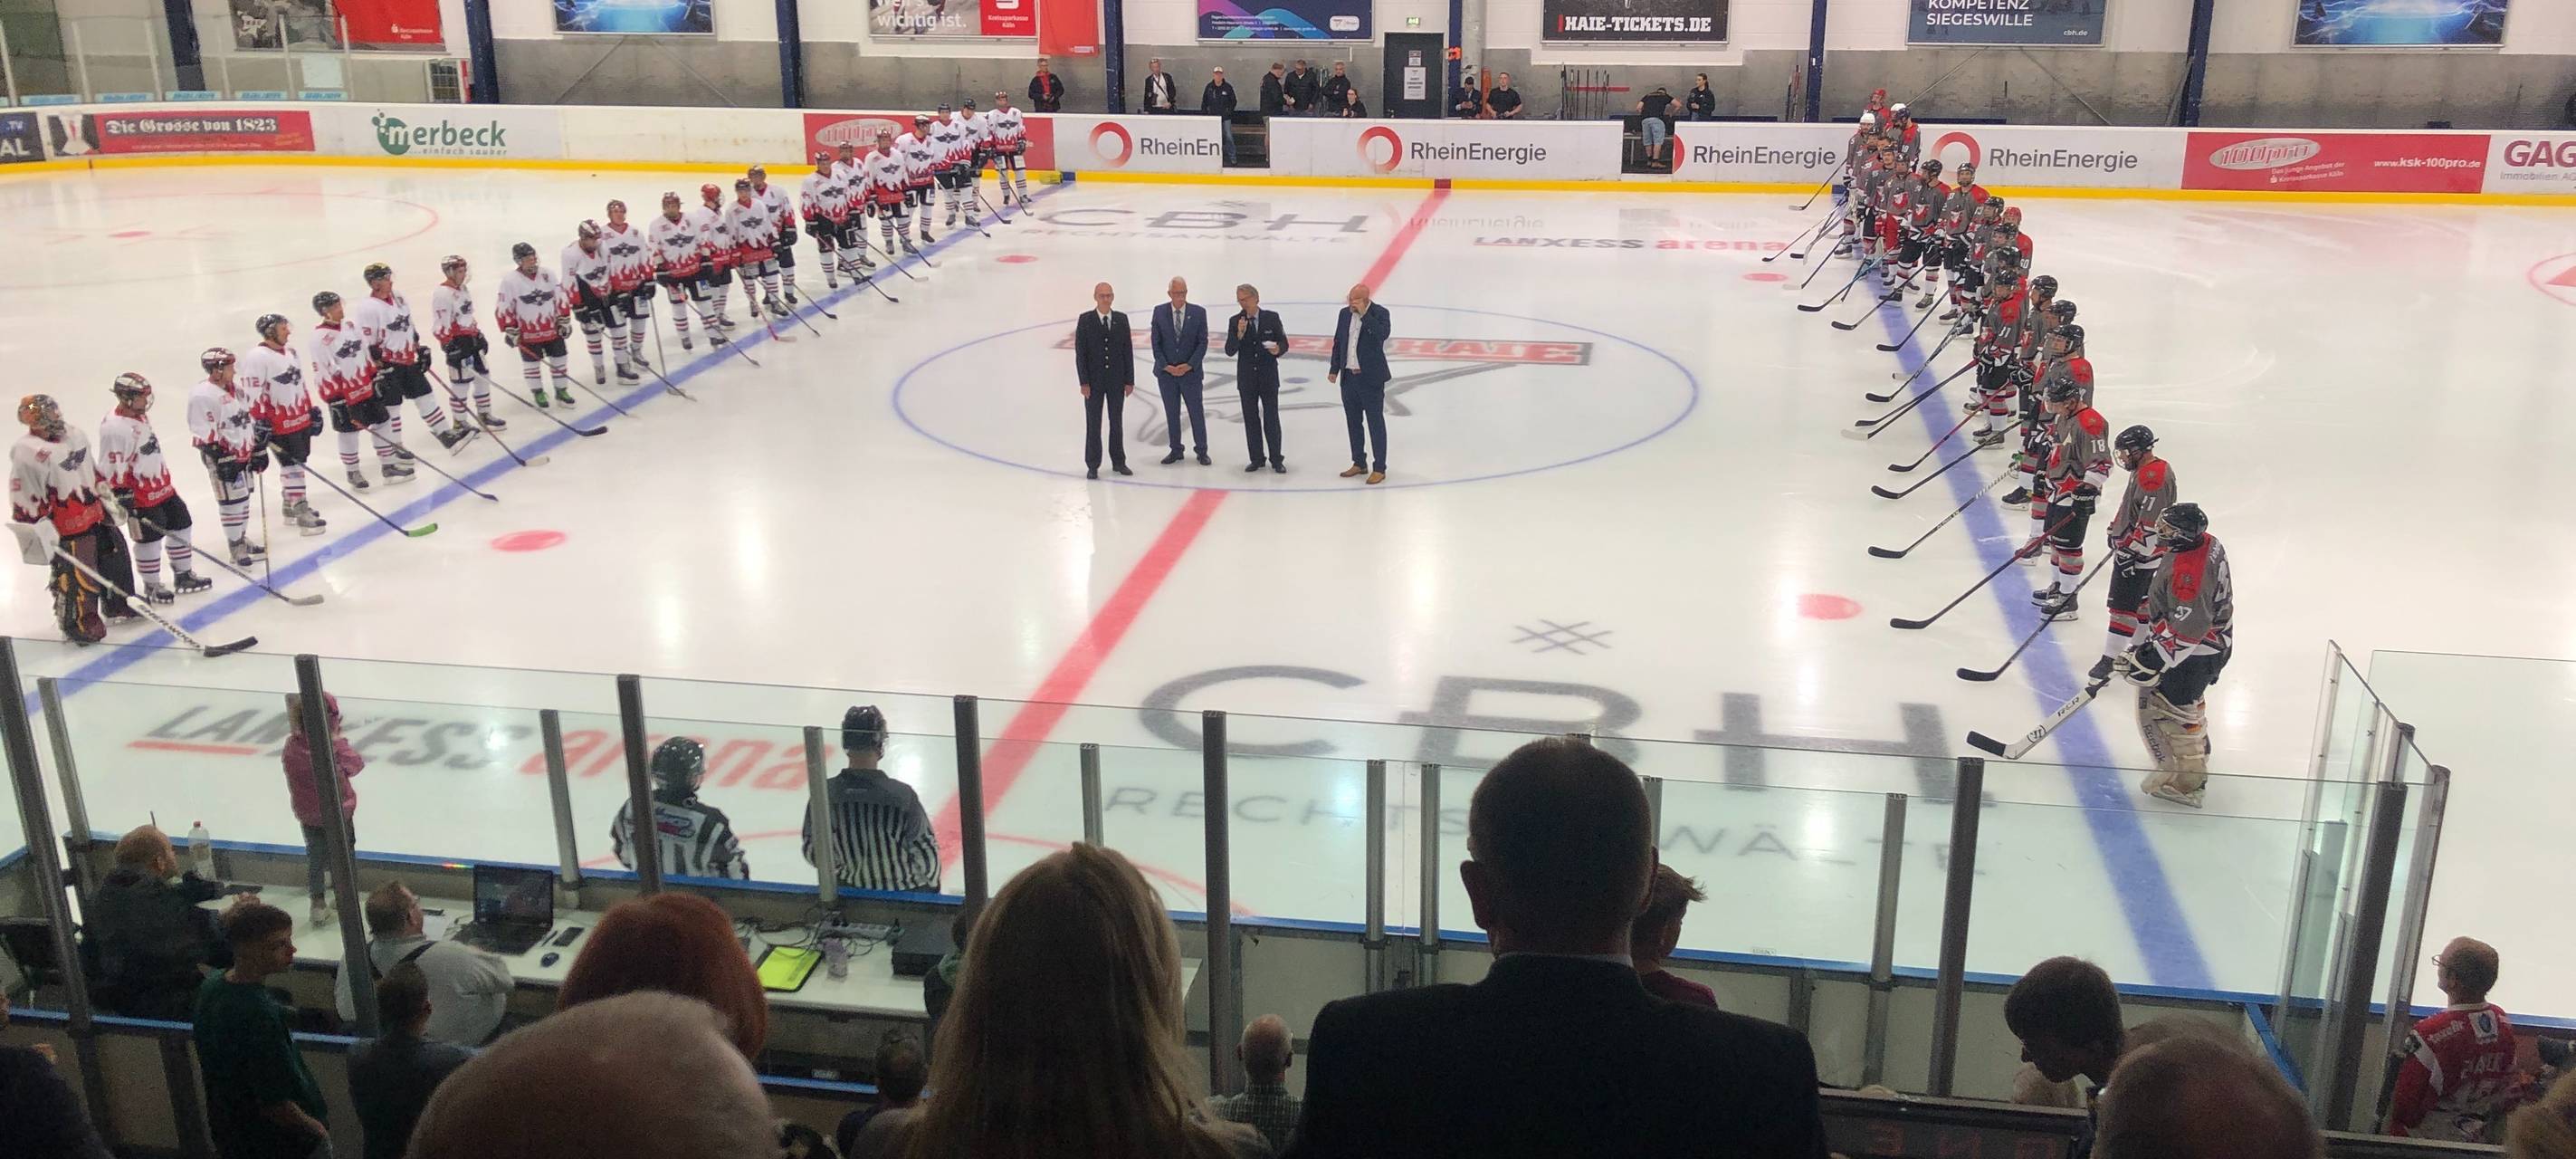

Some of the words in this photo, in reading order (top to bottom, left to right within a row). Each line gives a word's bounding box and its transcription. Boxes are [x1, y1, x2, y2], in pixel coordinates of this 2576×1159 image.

[1929, 0, 2029, 10] KOMPETENZ
[877, 12, 937, 31] wichtig
[941, 14, 967, 27] ist.
[1565, 16, 1712, 33] HAIE-TICKETS.DE
[1926, 13, 2033, 26] SIEGESWILLE
[106, 119, 136, 134] Die
[139, 118, 199, 133] Grosse
[203, 119, 231, 132] von
[235, 118, 277, 132] 1823
[387, 120, 507, 147] merbeck
[1140, 138, 1220, 156] RheinEn
[1411, 142, 1547, 165] RheinEnergie
[2221, 143, 2310, 167] 100pro
[2504, 139, 2576, 168] GAG
[1693, 144, 1837, 170] RheinEnergie
[1990, 148, 2138, 174] RheinEnergie
[2373, 158, 2482, 169] www.ksk-100pro.de
[2500, 171, 2558, 181] Immobilien
[1039, 209, 1370, 234] CBH
[1474, 236, 1645, 249] LANXESS
[1655, 238, 1790, 251] arena
[2091, 439, 2106, 454] 18
[2173, 605, 2193, 622] 37
